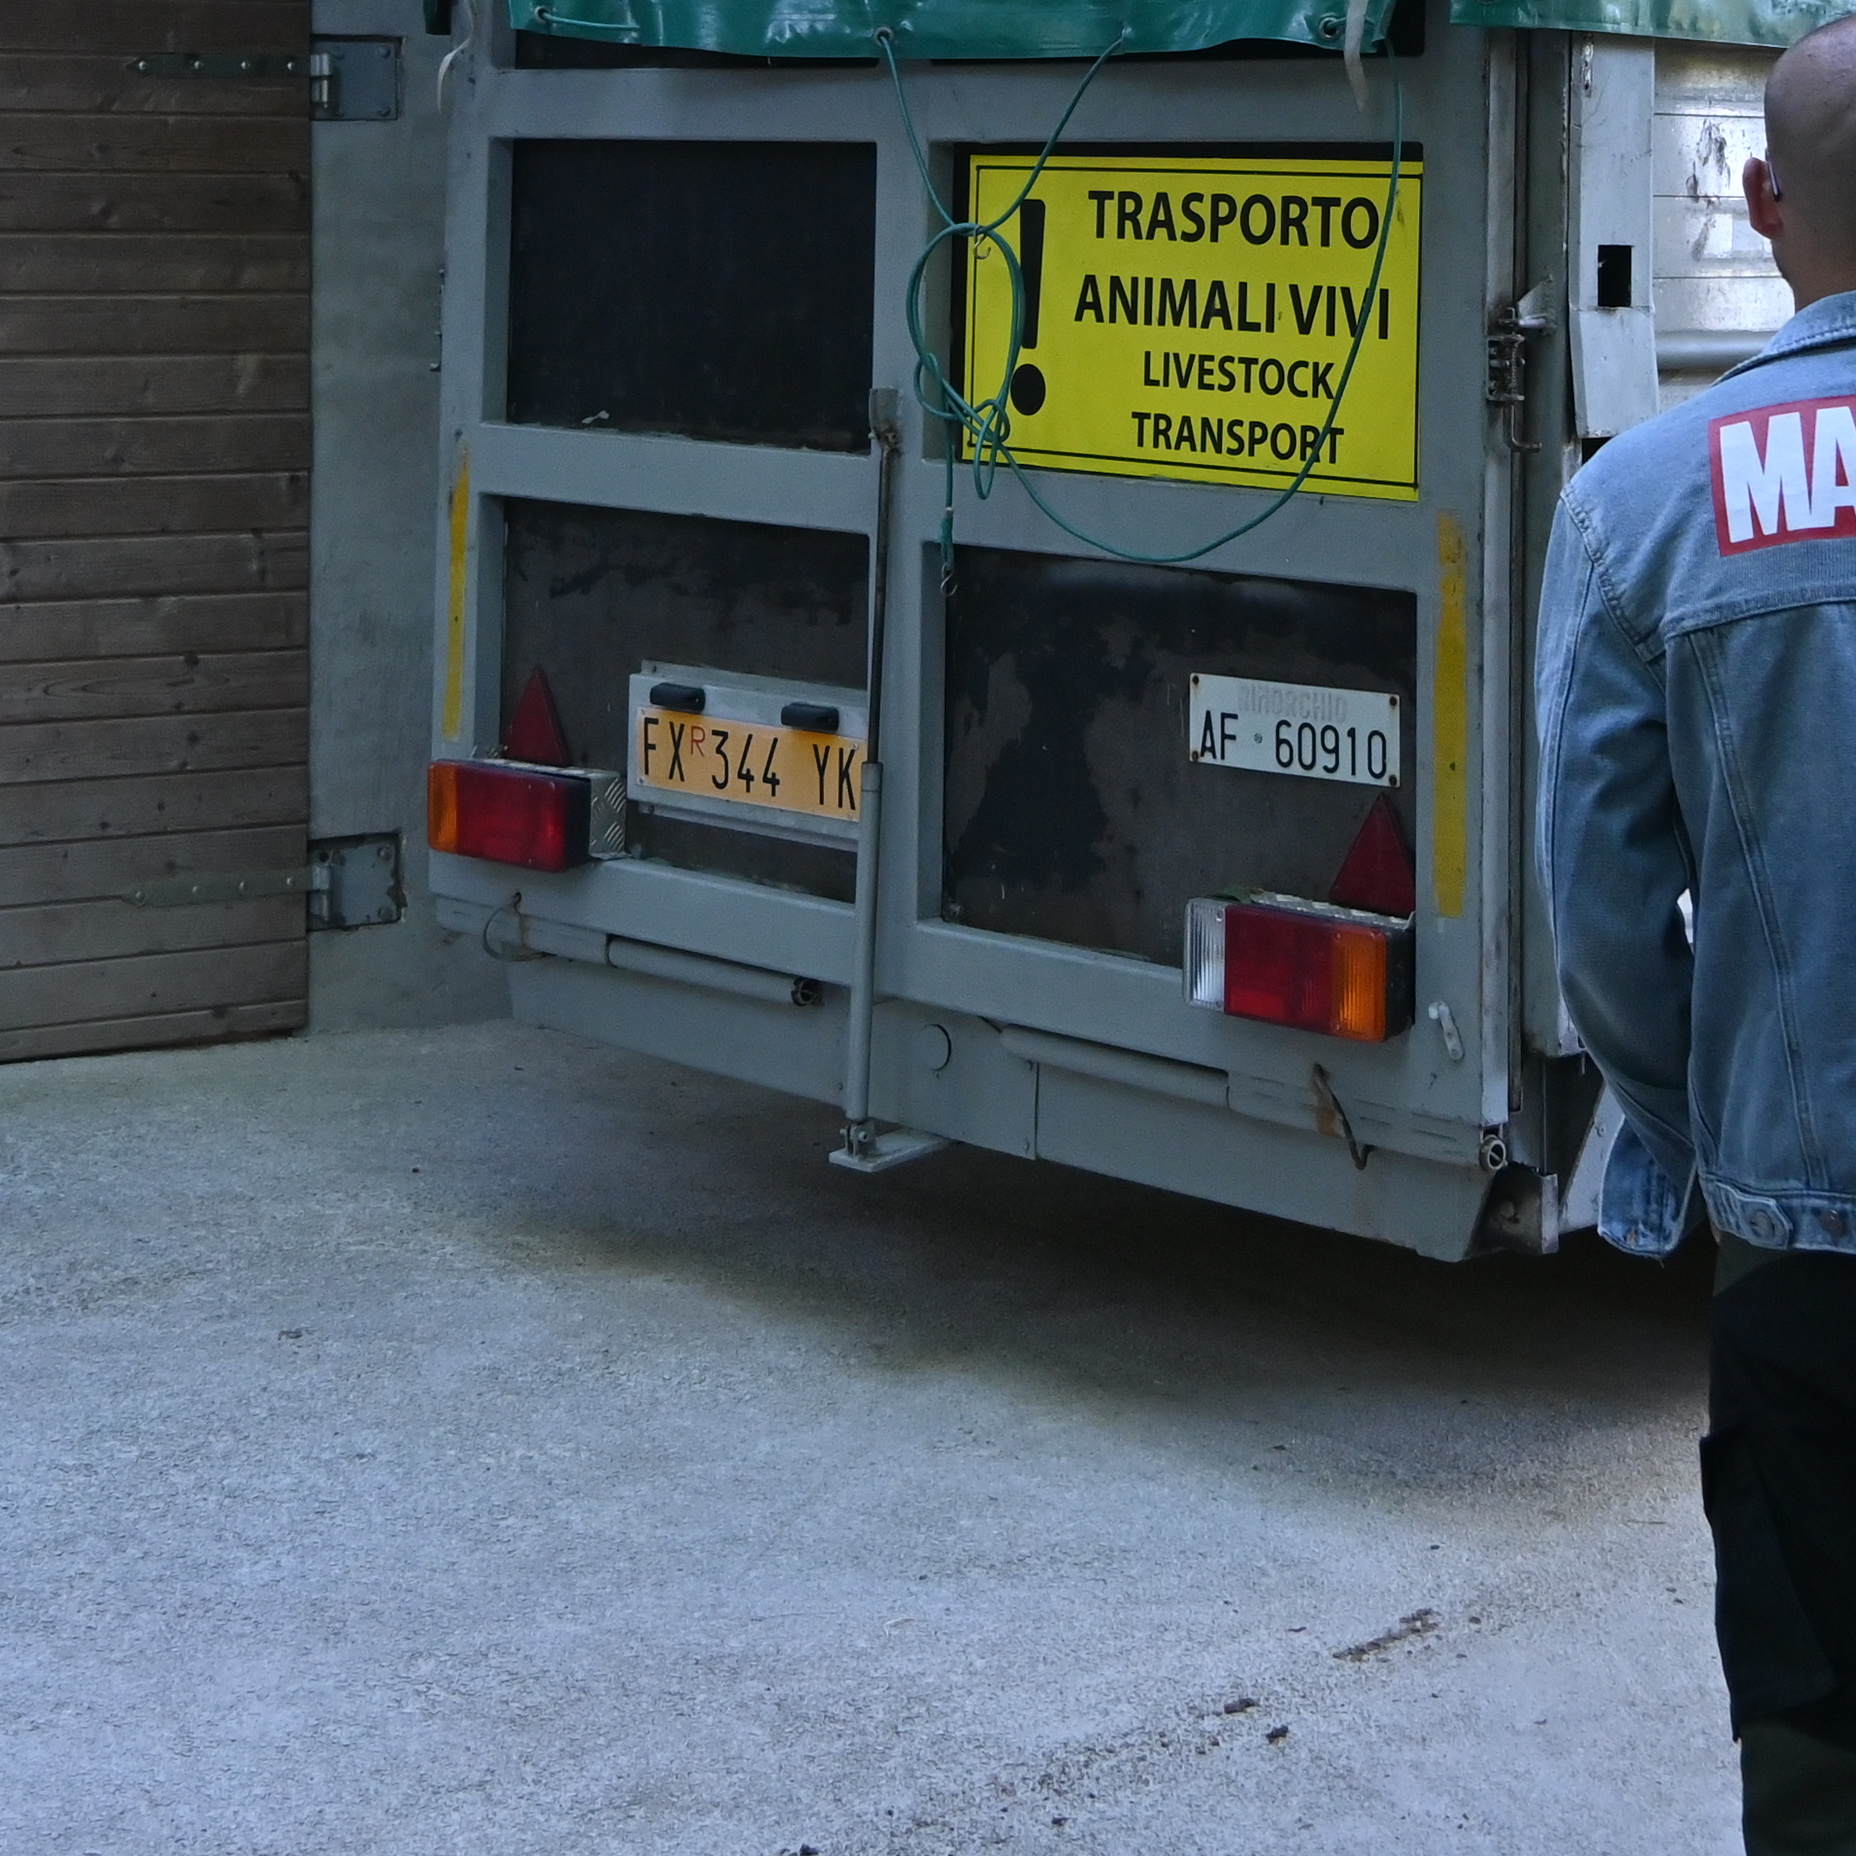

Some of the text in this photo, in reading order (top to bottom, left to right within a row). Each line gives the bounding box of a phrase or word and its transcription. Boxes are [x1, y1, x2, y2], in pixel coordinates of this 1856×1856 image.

[1088, 190, 1379, 249] TRASPORTO
[1074, 274, 1389, 340] ANIMALI VIVI
[1143, 351, 1336, 400] LIVESTOCK
[1132, 412, 1344, 464] TRANSPORT
[1200, 710, 1387, 779] AF 60910
[813, 744, 856, 810] YK
